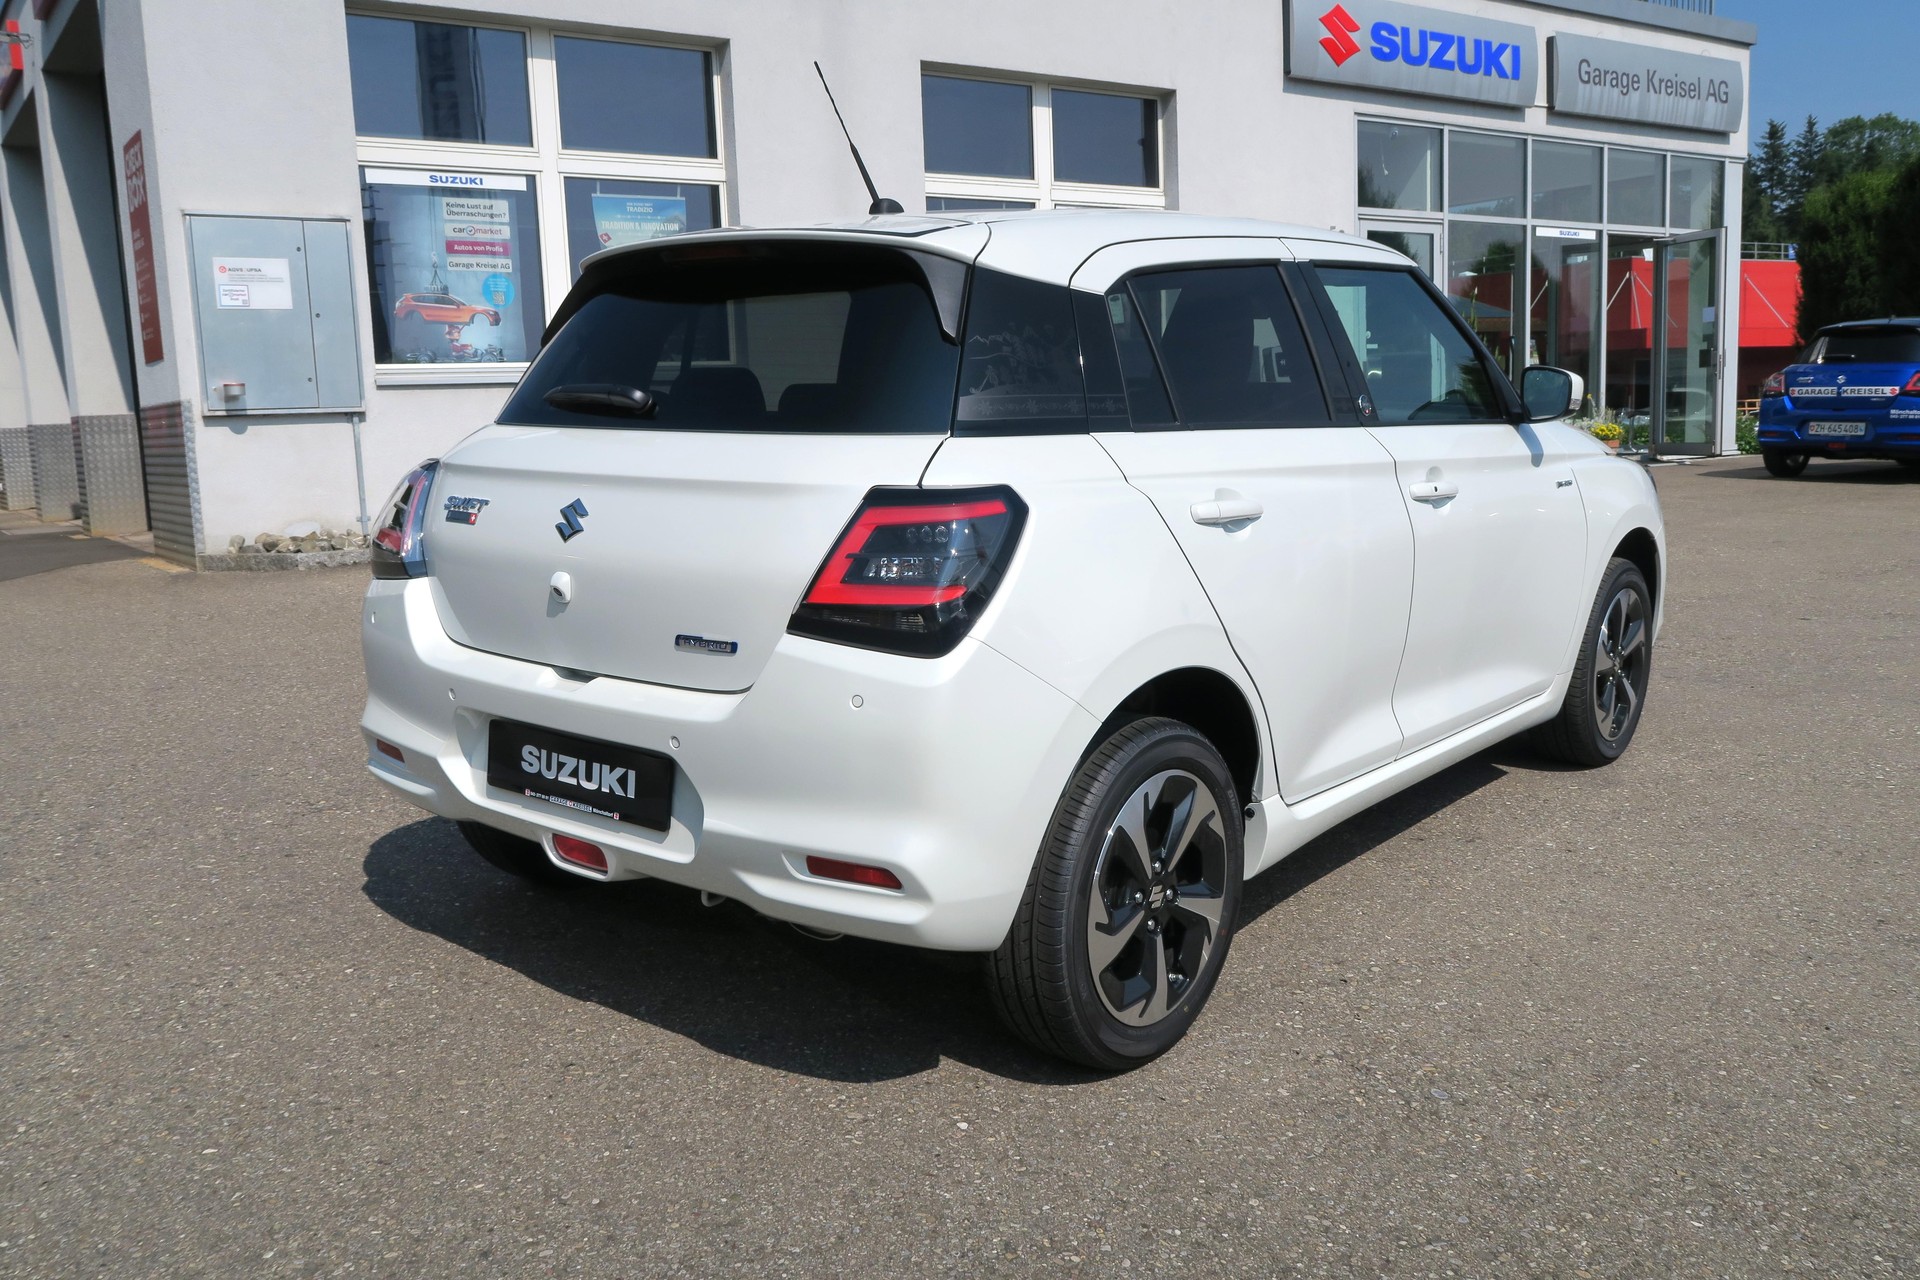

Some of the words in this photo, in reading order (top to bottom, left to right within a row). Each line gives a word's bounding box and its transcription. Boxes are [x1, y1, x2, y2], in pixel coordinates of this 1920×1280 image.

[1370, 21, 1521, 81] SUZUKI
[1578, 58, 1641, 96] Garage
[1646, 68, 1701, 100] Kreisel
[1706, 78, 1729, 104] AG
[429, 174, 484, 186] SUZUKI
[445, 201, 465, 209] Keine
[466, 202, 481, 210] Lust
[446, 208, 506, 219] Überraschungen?
[452, 226, 466, 234] car
[475, 226, 502, 235] market
[601, 221, 635, 230] TRADITION
[641, 221, 679, 231] INNOVATION
[448, 261, 475, 270] Garage
[475, 262, 499, 270] Kreisel
[1797, 388, 1836, 396] GARAGE
[1842, 387, 1887, 395] KREISEL
[520, 744, 636, 799] SUZUKI
